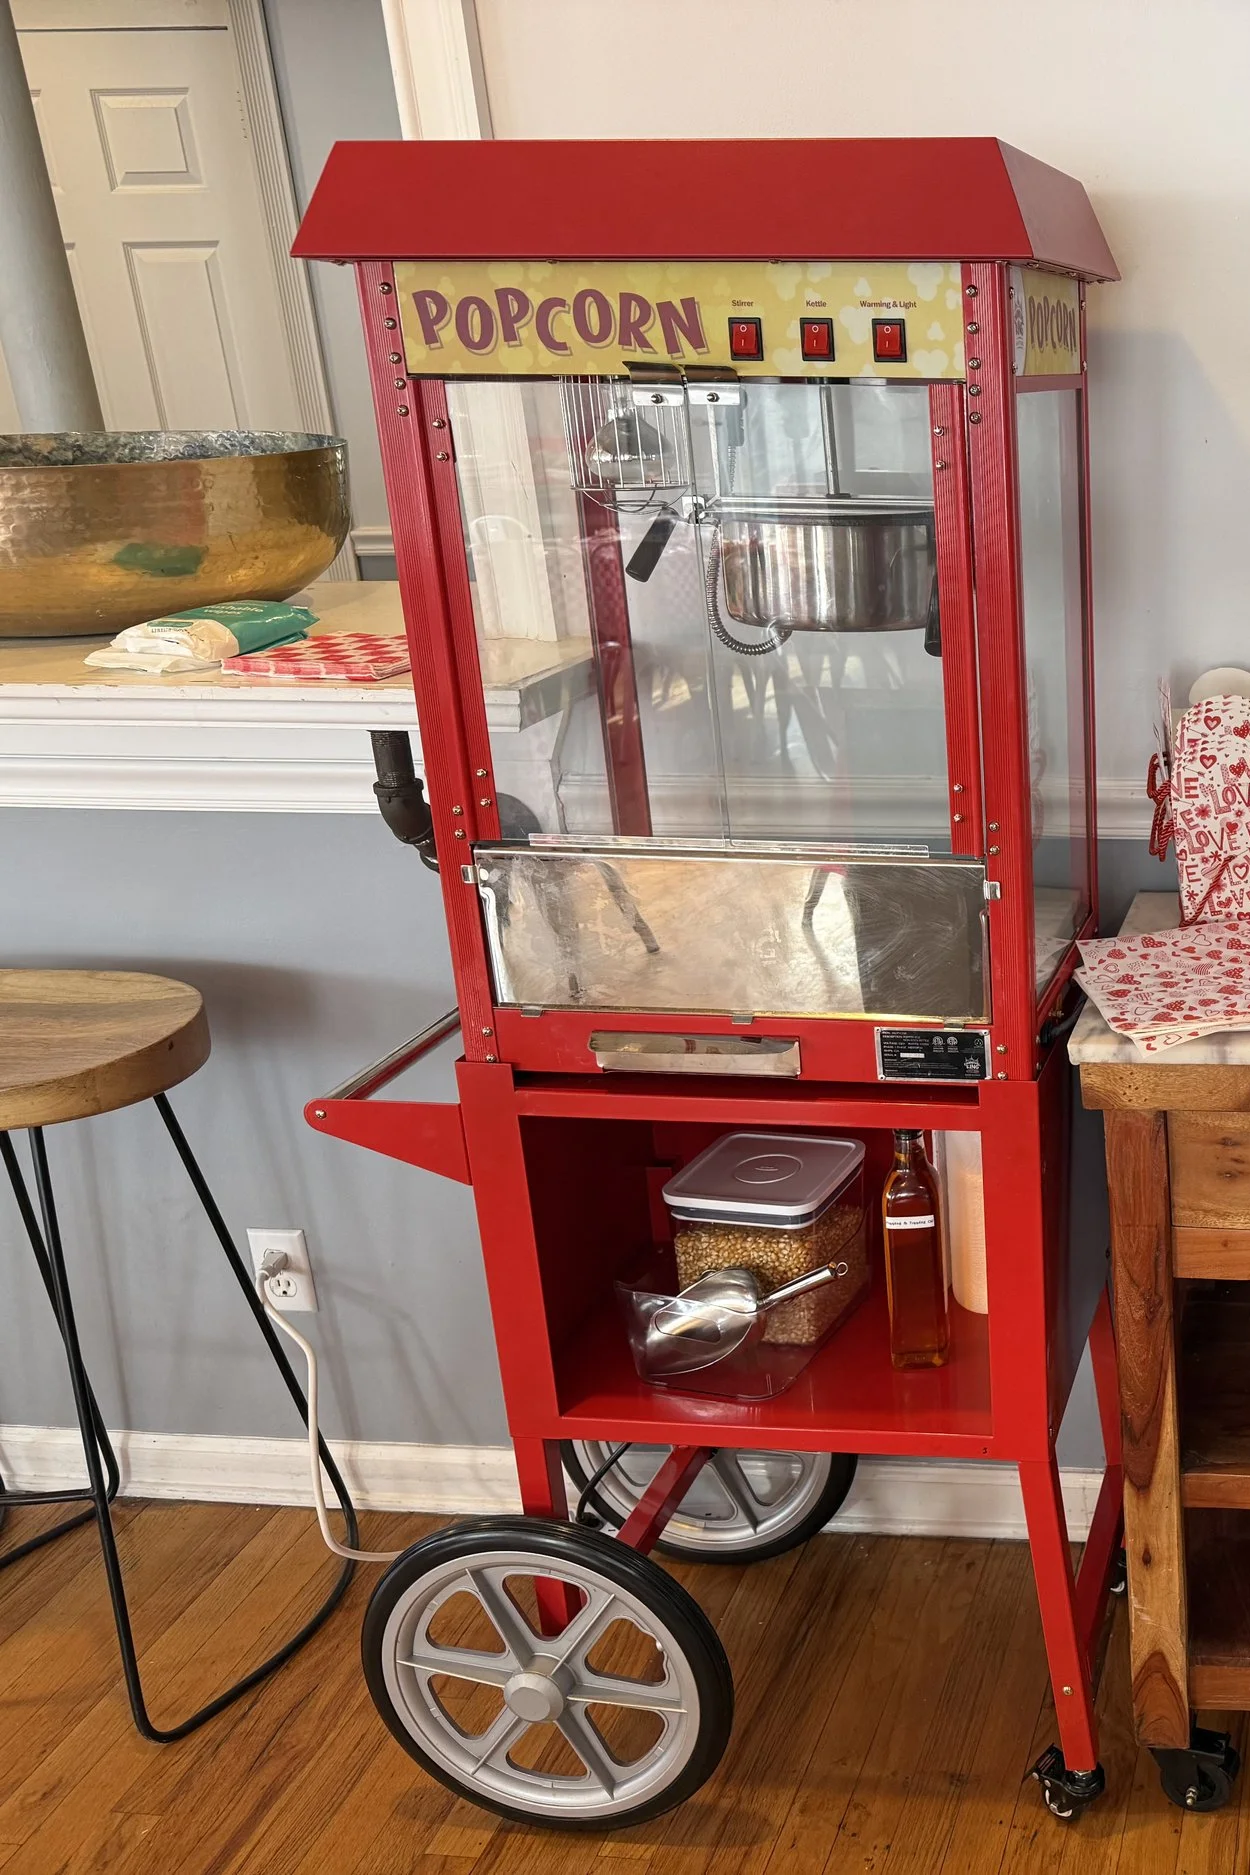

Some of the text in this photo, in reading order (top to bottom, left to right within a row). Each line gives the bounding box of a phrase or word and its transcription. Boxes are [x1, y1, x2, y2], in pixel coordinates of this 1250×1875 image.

[731, 299, 754, 307] Stirrer
[805, 299, 827, 308] Kettle
[859, 300, 917, 309] Warming & Light
[412, 287, 708, 357] POPCORN
[1028, 295, 1077, 356] POPCORN
[1185, 826, 1242, 855] LOVE
